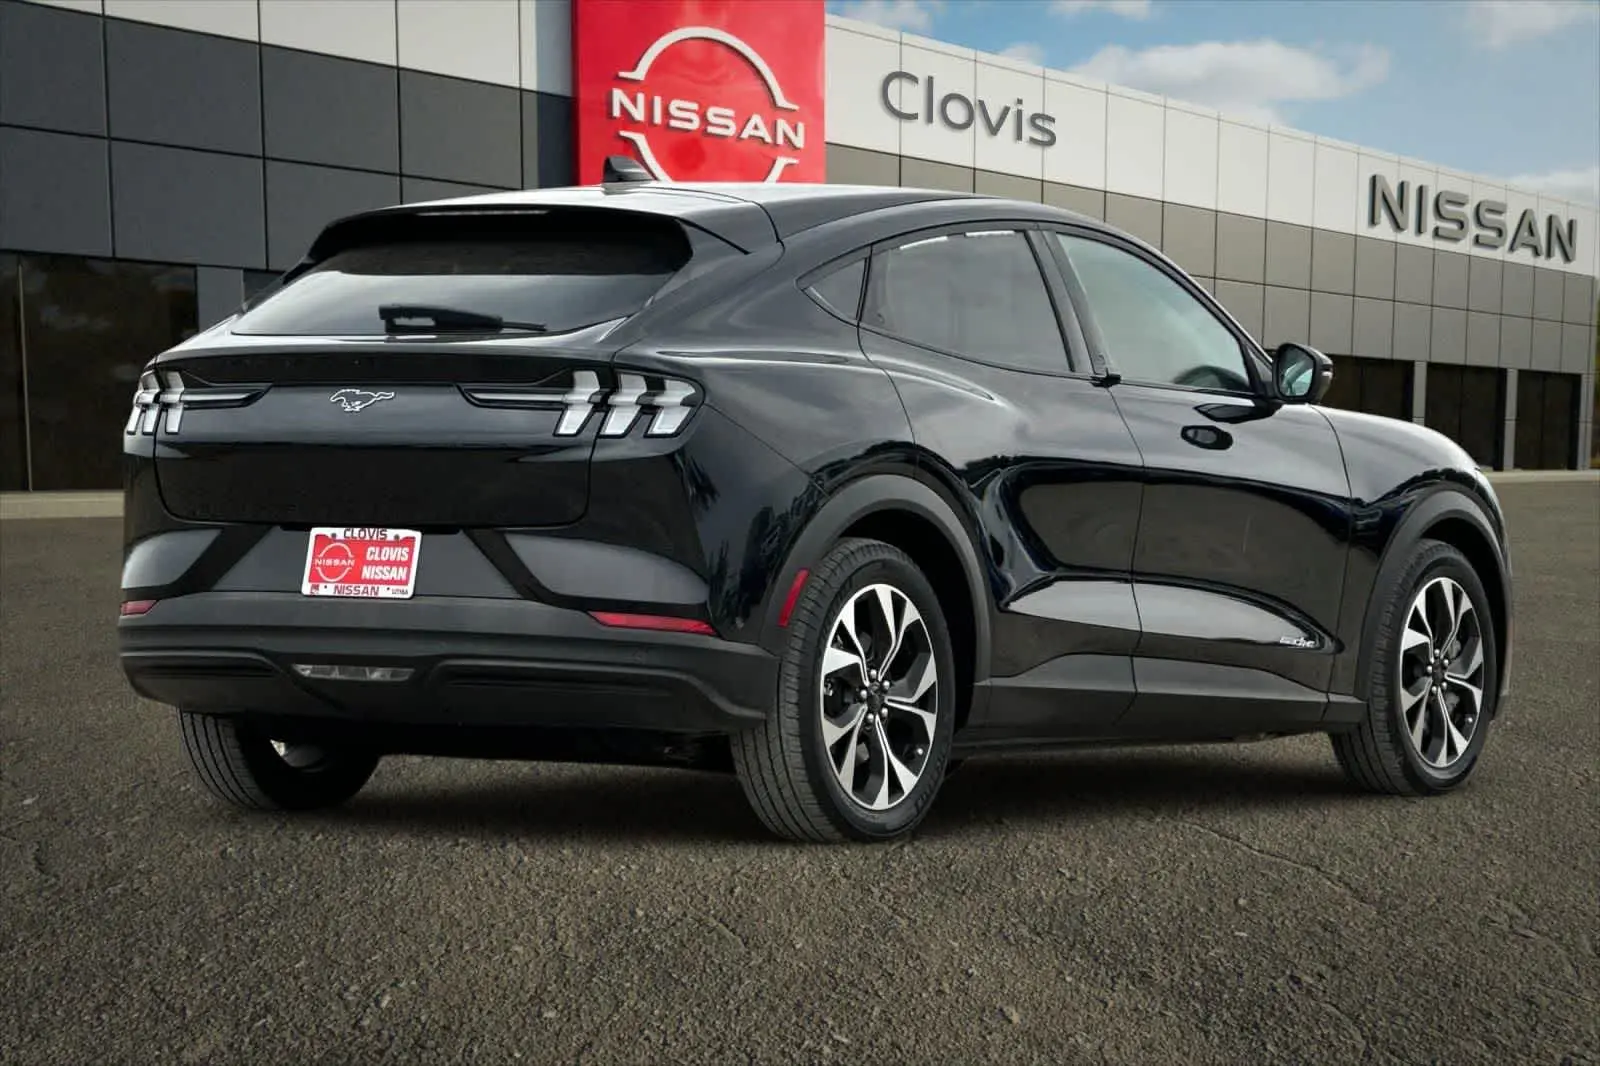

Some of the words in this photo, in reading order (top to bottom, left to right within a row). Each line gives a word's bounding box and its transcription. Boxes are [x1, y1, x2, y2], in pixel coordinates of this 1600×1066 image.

[882, 71, 1057, 147] Clovis
[611, 88, 805, 149] NISSAN
[1368, 174, 1577, 263] NISSAN
[343, 528, 388, 540] CLOVIS
[366, 546, 410, 561] CLOVIS
[314, 558, 355, 566] NISSAN
[361, 565, 408, 581] NISSAN
[333, 584, 380, 596] NISSAN
